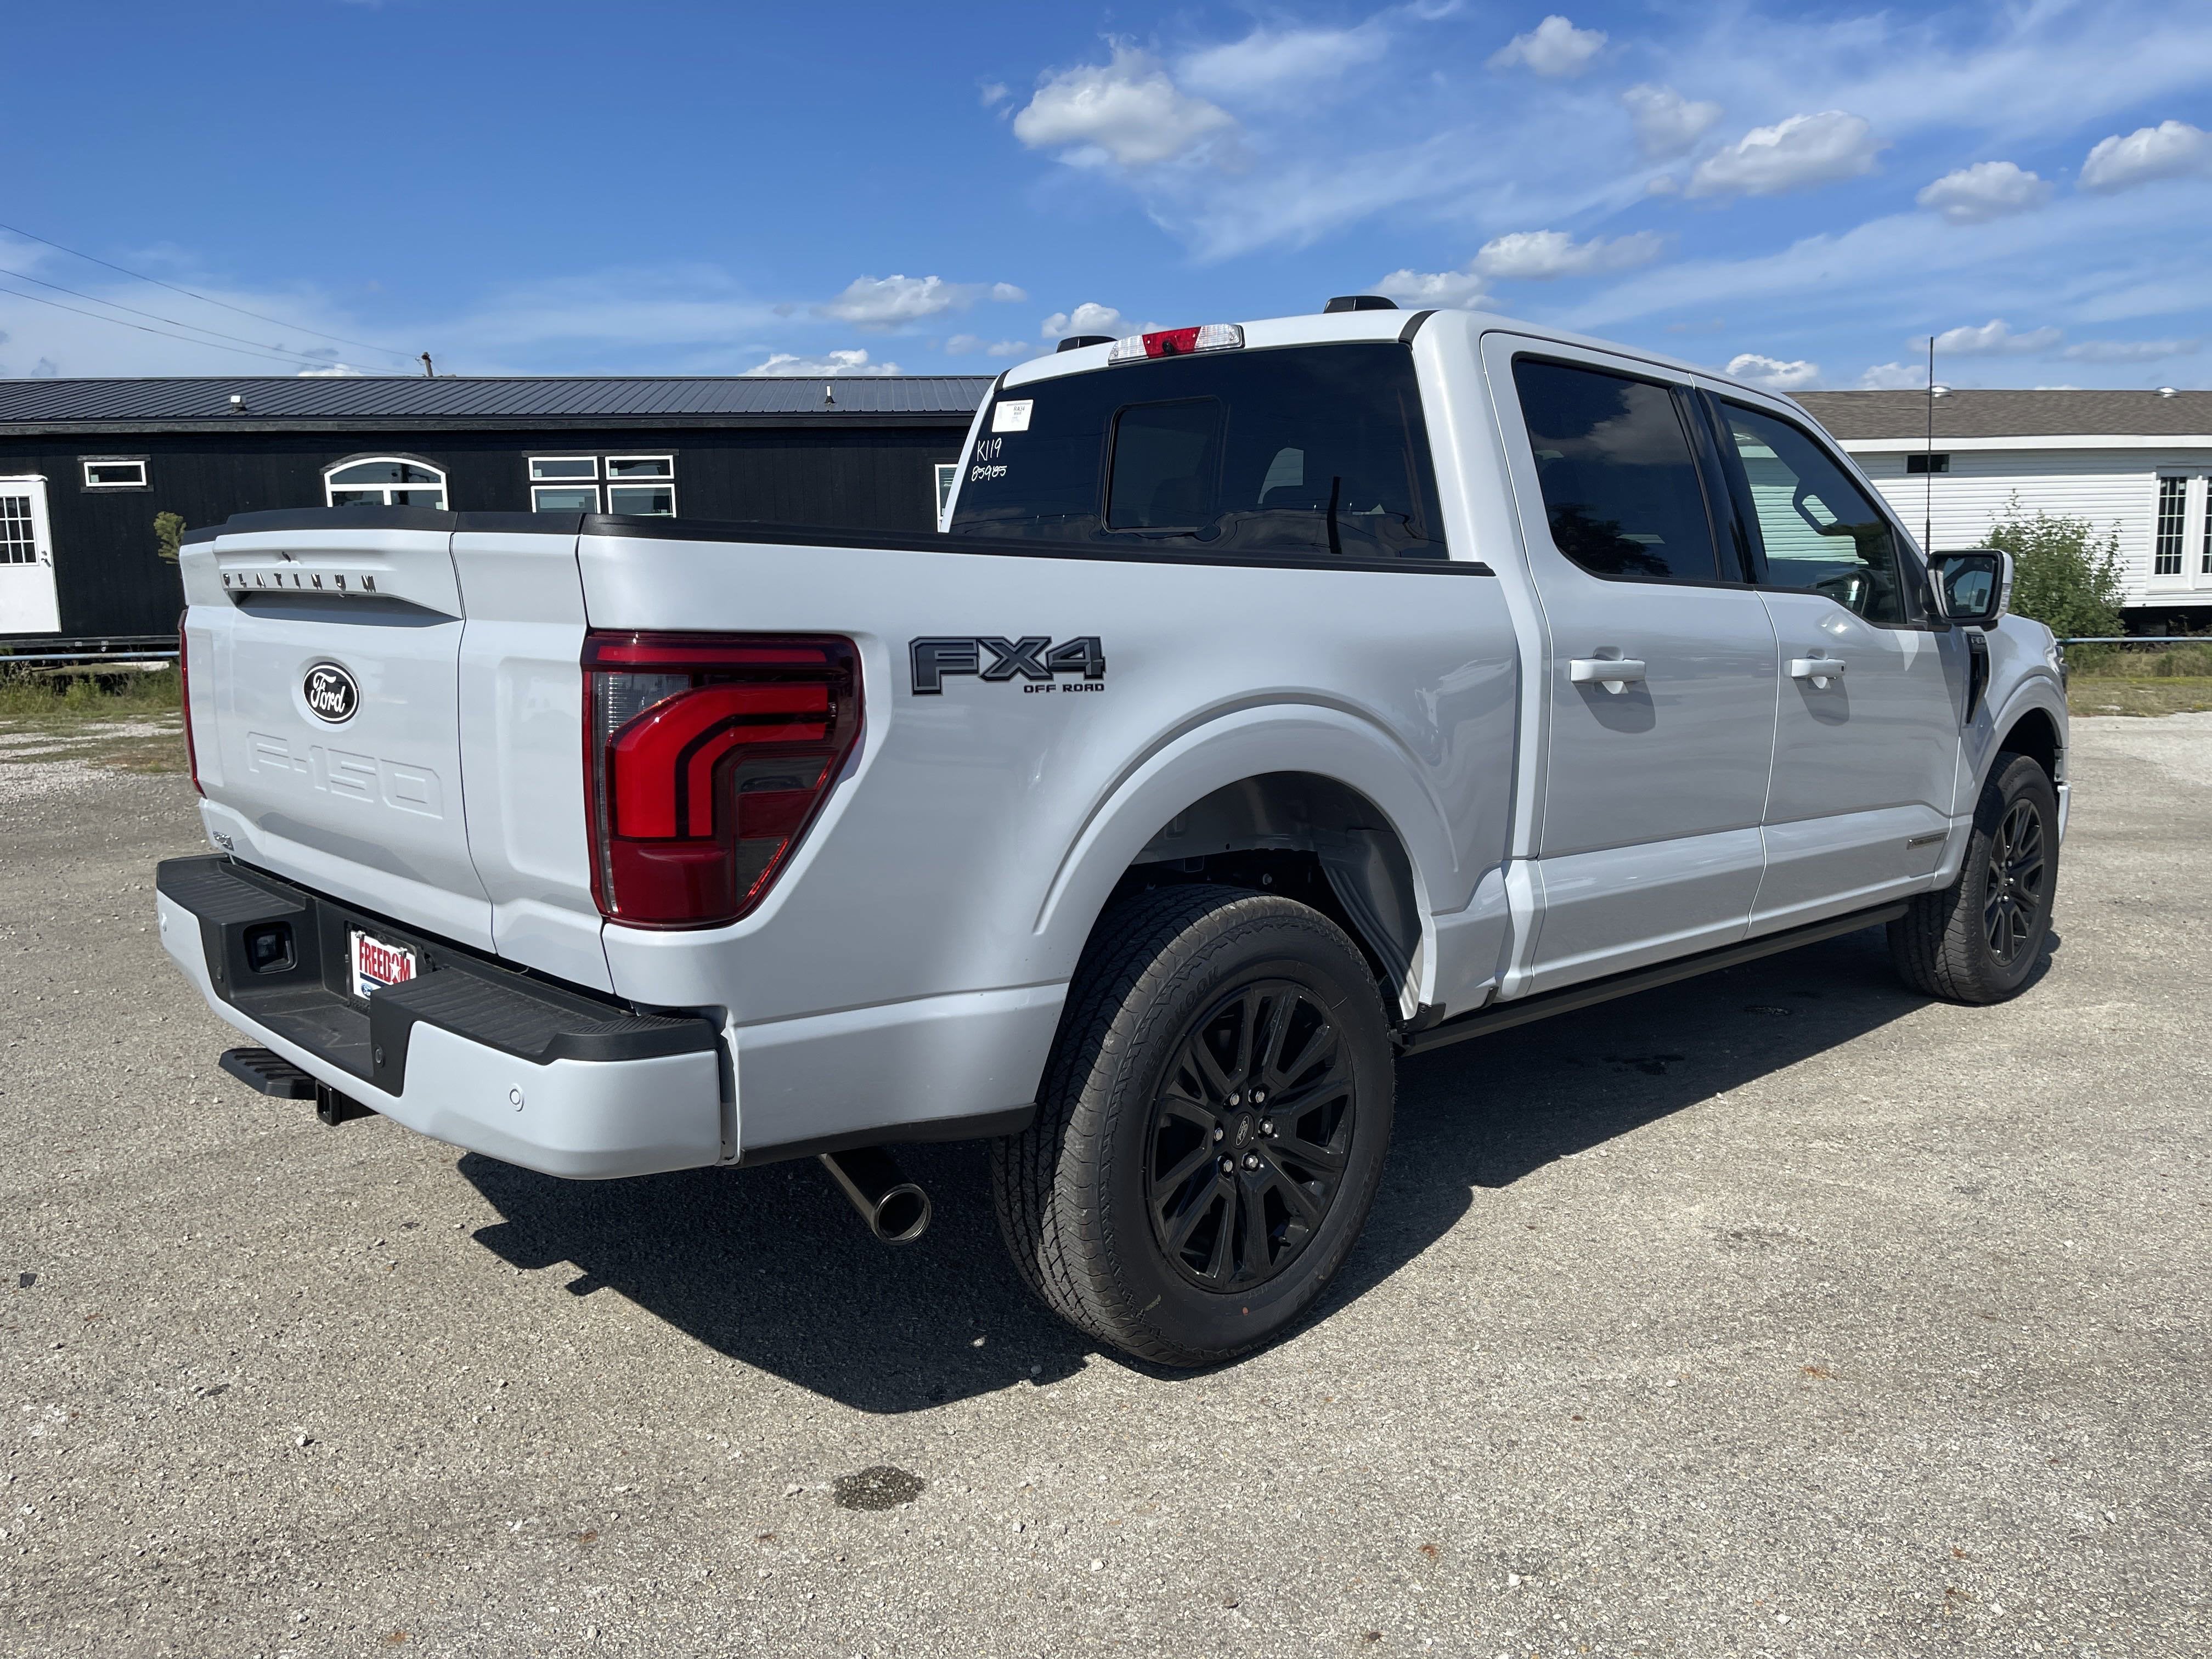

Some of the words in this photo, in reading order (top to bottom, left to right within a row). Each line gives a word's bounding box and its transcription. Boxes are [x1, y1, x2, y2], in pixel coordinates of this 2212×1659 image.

[977, 437, 1002, 462] K119
[971, 465, 1007, 482] 85985
[223, 572, 377, 592] PLATINUM
[908, 636, 1105, 696] FX4
[311, 672, 346, 713] Ford
[1024, 685, 1056, 693] OFF
[1062, 684, 1105, 692] ROAD
[247, 731, 443, 820] F-150
[359, 938, 411, 984] FREEDOM
